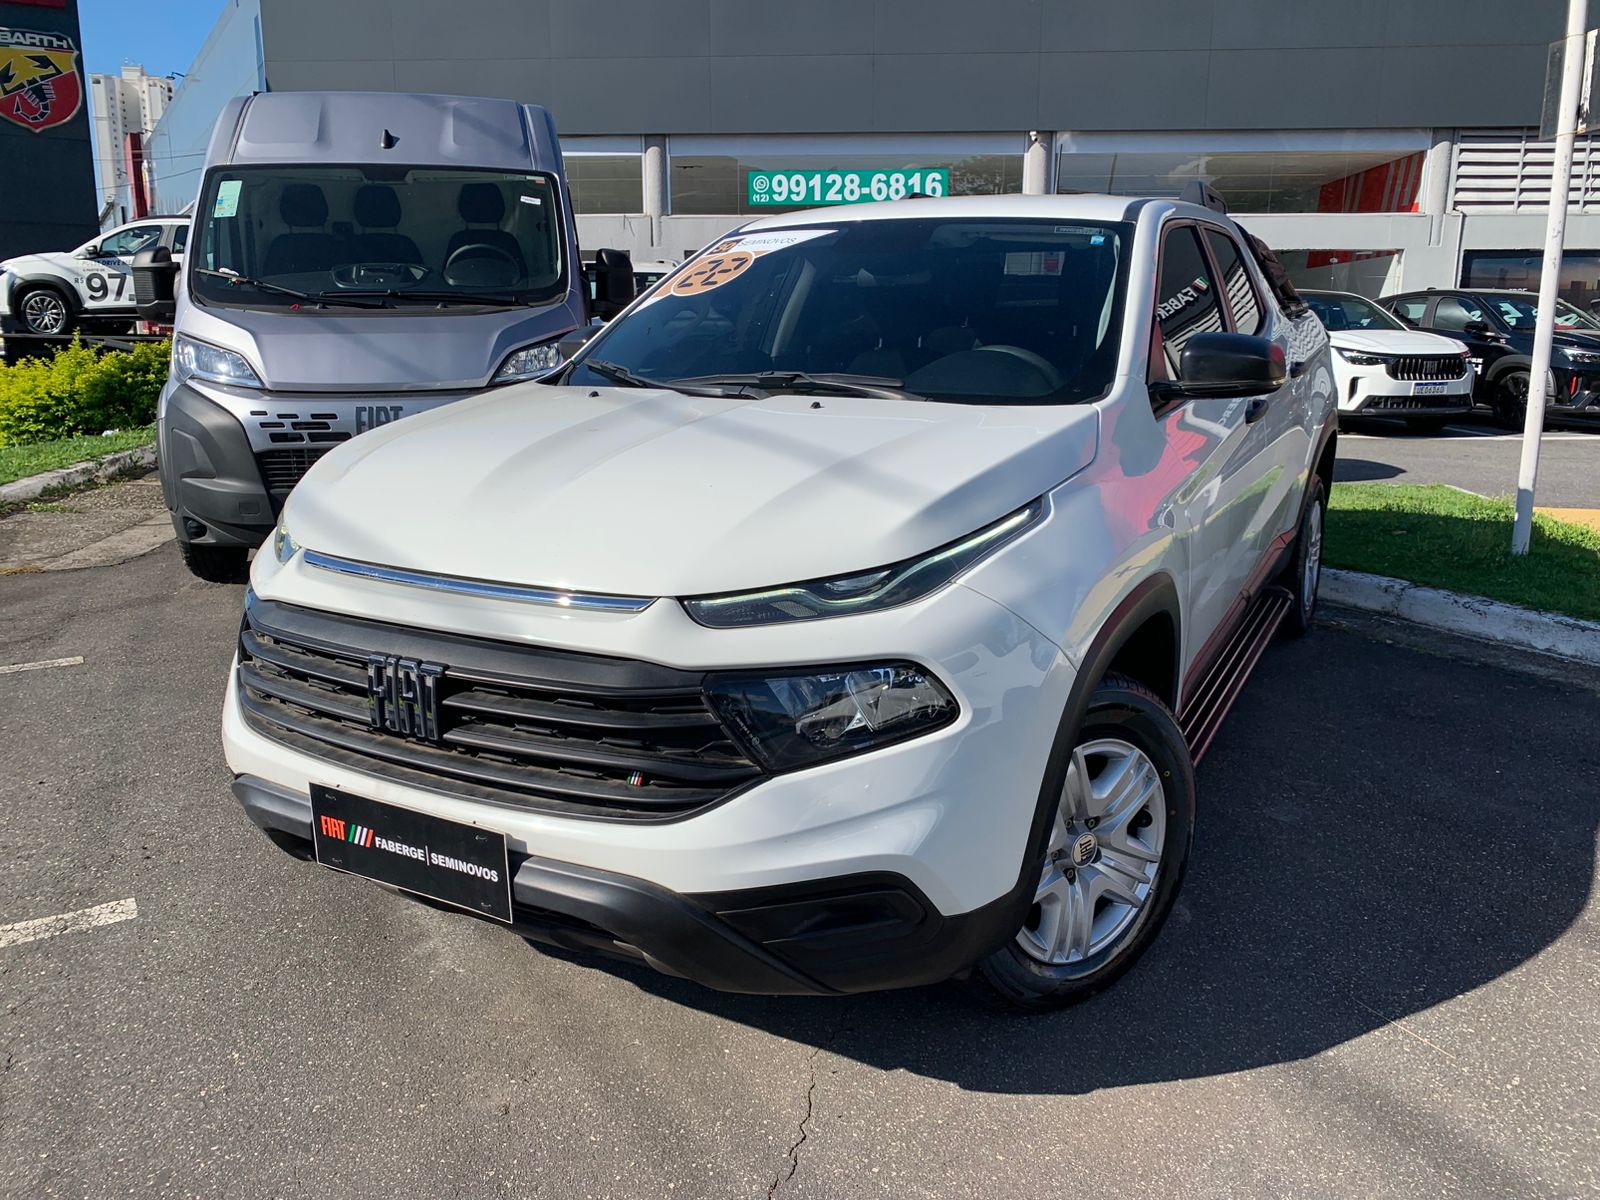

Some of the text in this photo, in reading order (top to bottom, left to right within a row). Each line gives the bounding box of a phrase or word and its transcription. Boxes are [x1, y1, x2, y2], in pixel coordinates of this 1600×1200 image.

[753, 172, 943, 203] (12) 99128-6816
[677, 258, 749, 289] 22
[355, 405, 403, 436] FIAT
[367, 652, 448, 741] FIAT
[320, 815, 500, 883] FIAT FABERGE SEMINOVOS
